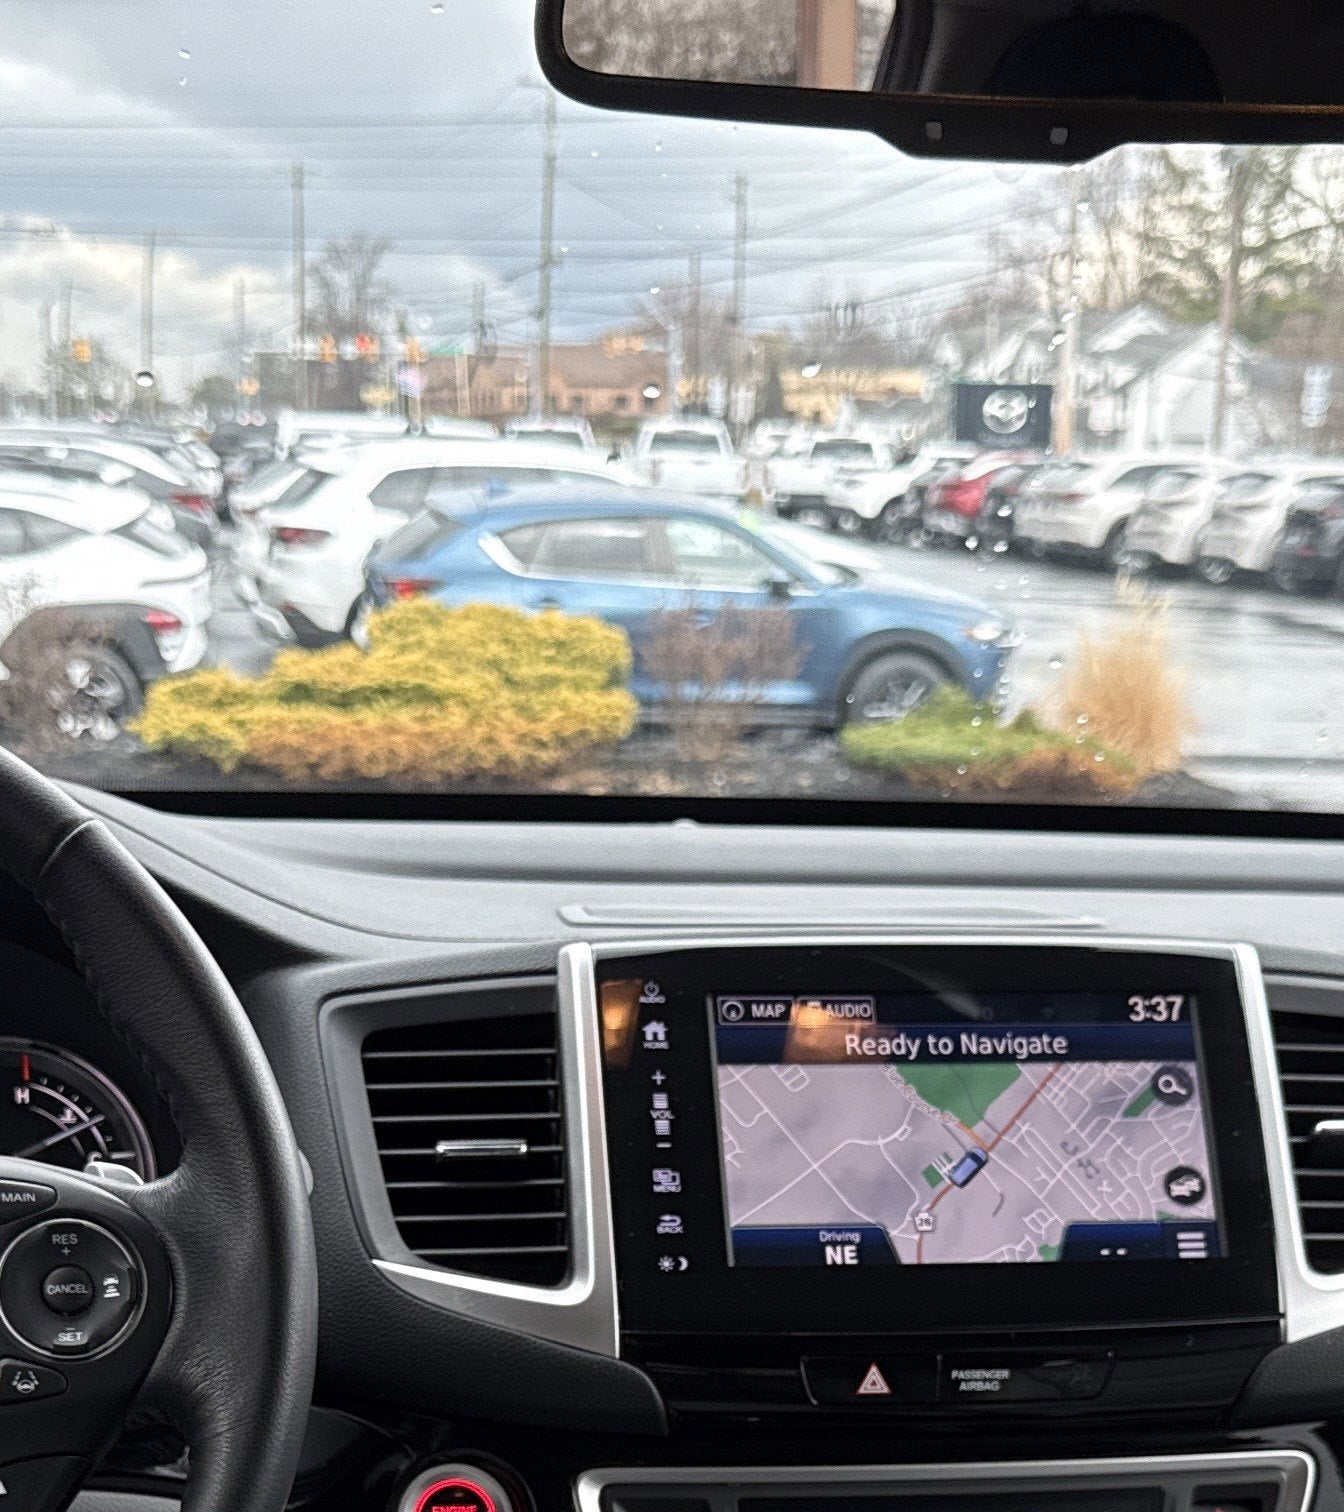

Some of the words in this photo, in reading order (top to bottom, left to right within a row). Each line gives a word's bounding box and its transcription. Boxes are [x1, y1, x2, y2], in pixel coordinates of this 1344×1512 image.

[751, 1003, 786, 1018] MAP
[824, 1002, 872, 1018] AUDIO
[1127, 995, 1184, 1022] 3:37
[844, 1033, 921, 1060] Ready
[927, 1036, 955, 1056] to
[960, 1033, 1069, 1060] Navigate
[13, 1085, 30, 1105] H
[650, 1109, 676, 1120] VOL
[0, 1191, 37, 1203] MAIN
[51, 1233, 79, 1246] RES
[819, 1230, 862, 1245] Driving
[824, 1244, 860, 1266] NE
[47, 1283, 89, 1296] CANCEL
[57, 1331, 84, 1343] SET
[951, 1368, 1011, 1381] PASSENGER
[958, 1380, 1001, 1392] AIRBAG
